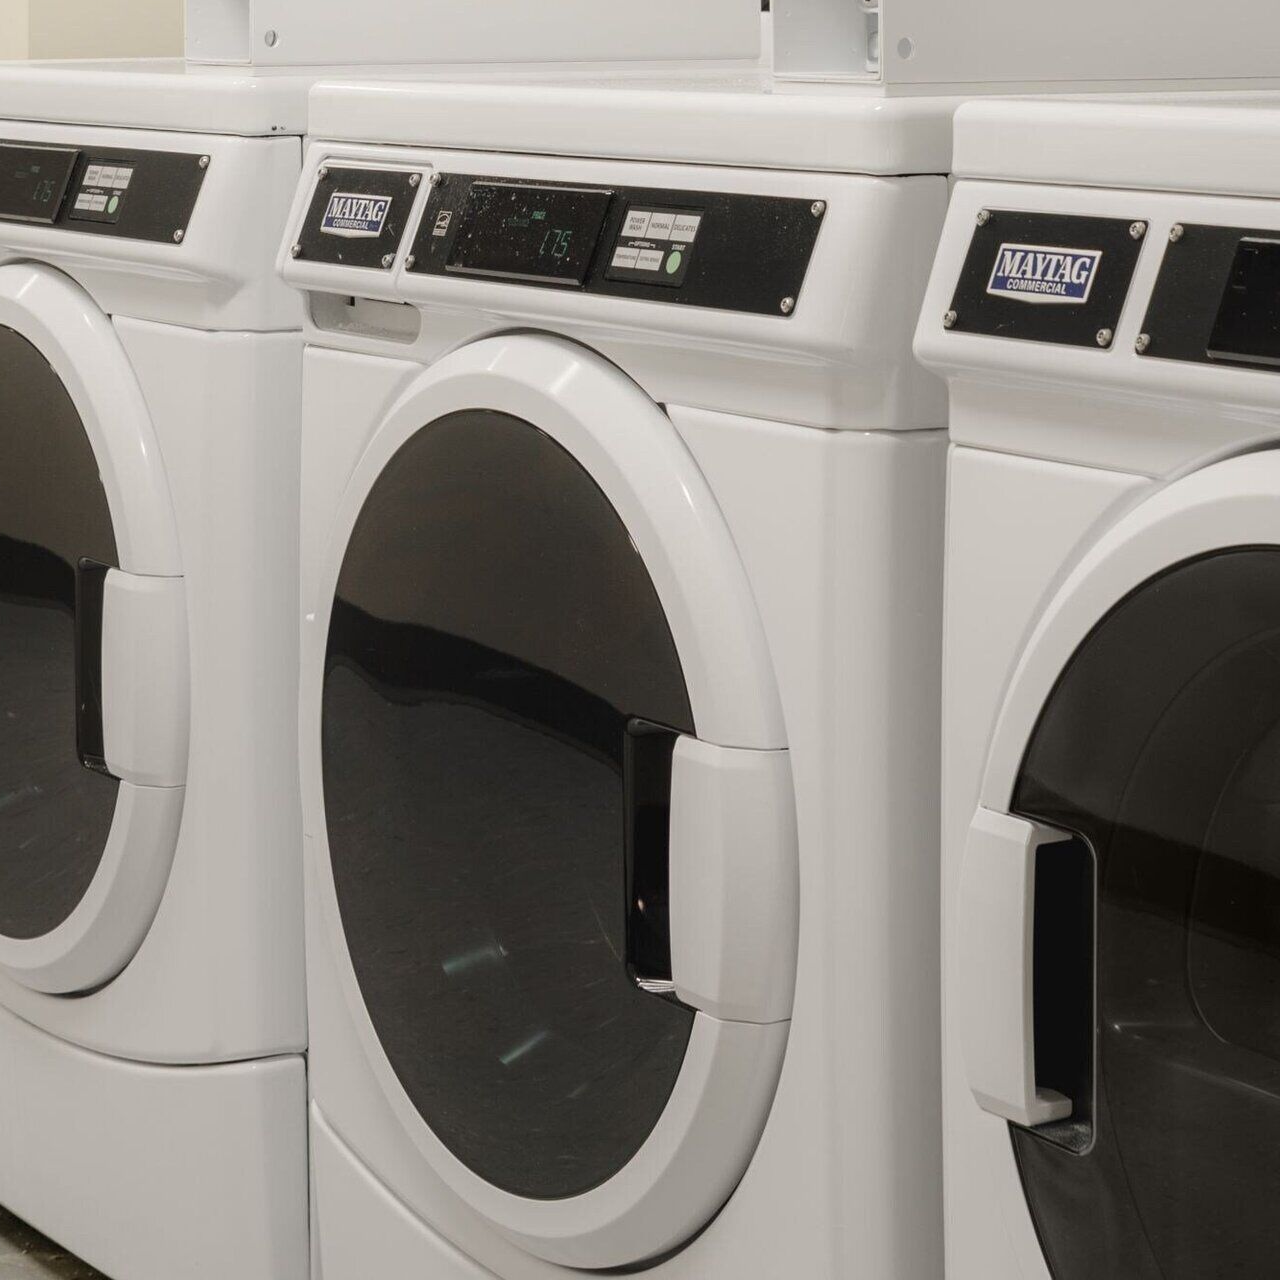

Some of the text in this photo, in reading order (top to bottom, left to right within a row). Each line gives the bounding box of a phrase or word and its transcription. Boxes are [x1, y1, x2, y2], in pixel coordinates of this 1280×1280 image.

[327, 197, 386, 222] MAYTAG
[996, 250, 1092, 285] MAYTAG
[1006, 278, 1067, 295] COMMERCIAL
